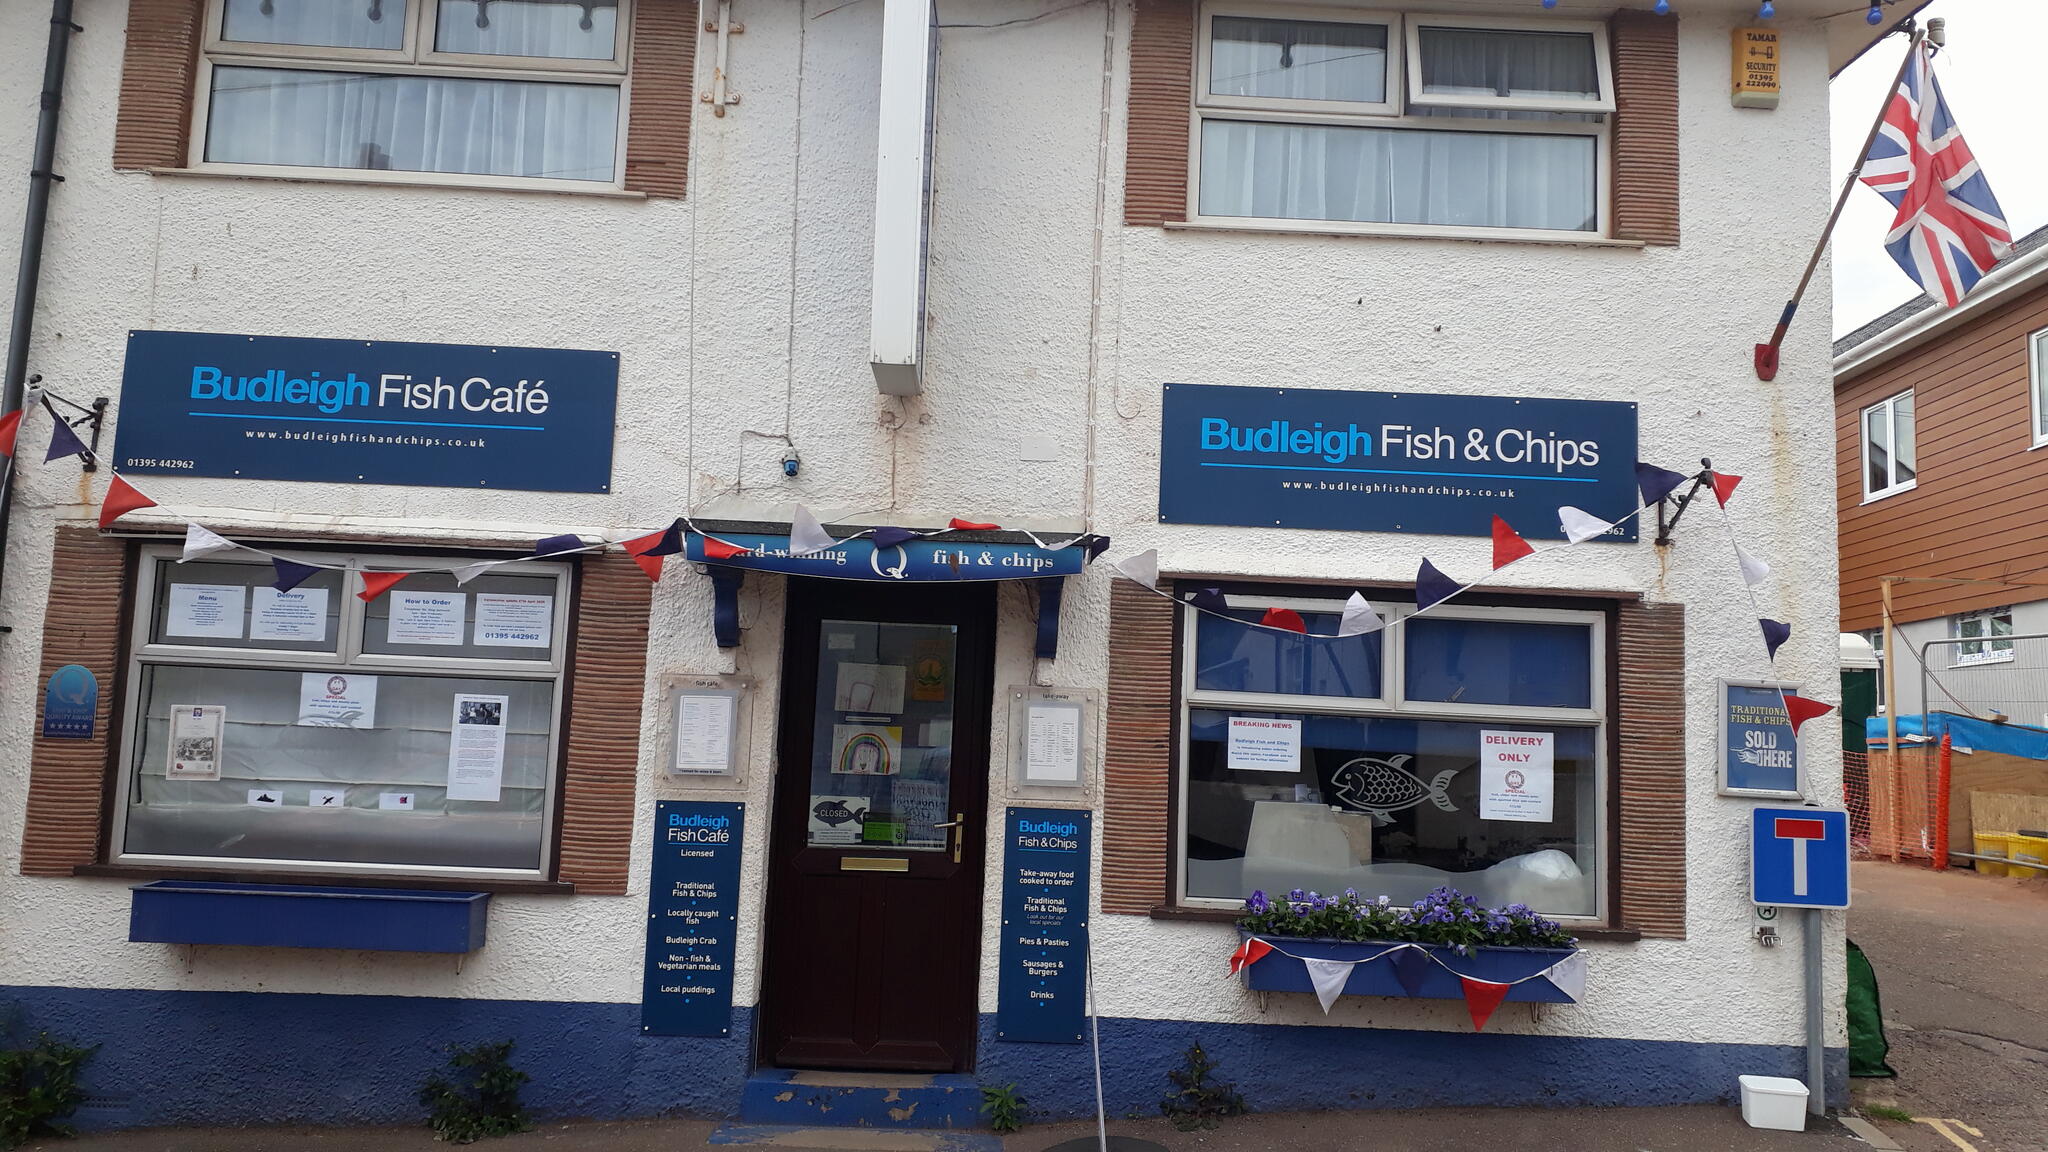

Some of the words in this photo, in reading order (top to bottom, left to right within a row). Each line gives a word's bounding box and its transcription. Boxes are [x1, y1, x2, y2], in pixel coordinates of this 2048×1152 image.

[1746, 32, 1777, 42] TAMAR
[1746, 61, 1776, 71] SECURITY
[1748, 73, 1773, 81] 01395
[190, 366, 370, 414] Budleigh
[378, 374, 455, 410] Fish
[460, 377, 549, 415] Café
[245, 430, 486, 448] www.budleighfishandchips.co.uk
[1201, 417, 1372, 464] Budleigh
[1381, 424, 1455, 460] Fish
[1463, 428, 1491, 461] &
[1495, 428, 1600, 473] Chips
[127, 458, 157, 467] 01395
[158, 459, 195, 469] 442962
[1282, 480, 1515, 498] www.budleighfishandchips.co.uk
[977, 550, 995, 566] &
[1001, 552, 1054, 573] chips
[276, 592, 305, 600] Delivery
[485, 632, 509, 640] 01395
[510, 633, 540, 641] 442962
[1233, 720, 1270, 728] BREAKING
[1731, 714, 1752, 723] FISH
[1754, 716, 1761, 724] &
[1763, 716, 1790, 725] CHIPS
[1486, 735, 1544, 746] DELIVERY
[1745, 730, 1777, 749] SOLD
[1498, 753, 1531, 763] ONLY
[1763, 750, 1792, 768] HERE
[820, 808, 849, 818] CLOSED
[669, 813, 730, 830] Budleigh
[1019, 820, 1078, 837] Budleigh
[668, 828, 696, 842] Fish
[697, 828, 730, 843] Café
[1018, 836, 1039, 847] Fish
[1040, 837, 1048, 848] &
[1049, 837, 1078, 850] Chips
[680, 849, 714, 857] Licensed
[1020, 869, 1058, 879] Take-away
[1058, 870, 1075, 878] food
[676, 881, 715, 890] Traditional
[1019, 877, 1045, 885] cooked
[1053, 878, 1074, 886] order
[672, 889, 688, 897] Fish
[696, 890, 717, 899] Chips
[1027, 896, 1065, 905] Traditional
[667, 909, 694, 918] Locally
[694, 910, 719, 919] caught
[1024, 904, 1039, 912] Fish
[1040, 904, 1047, 912] &
[1047, 905, 1068, 914] Chips
[685, 917, 700, 925] fish
[665, 936, 698, 946] Budleigh
[699, 937, 717, 945] Crab
[1019, 937, 1035, 945] Pies
[1036, 937, 1042, 945] &
[1043, 938, 1070, 947] Pasties
[658, 962, 697, 971] Vegetarian
[698, 963, 721, 971] meals
[1022, 959, 1057, 969] Sausages
[1058, 960, 1064, 968] &
[1028, 967, 1058, 977] Burgers
[681, 985, 716, 995] puddings
[1030, 990, 1055, 999] Drinks
